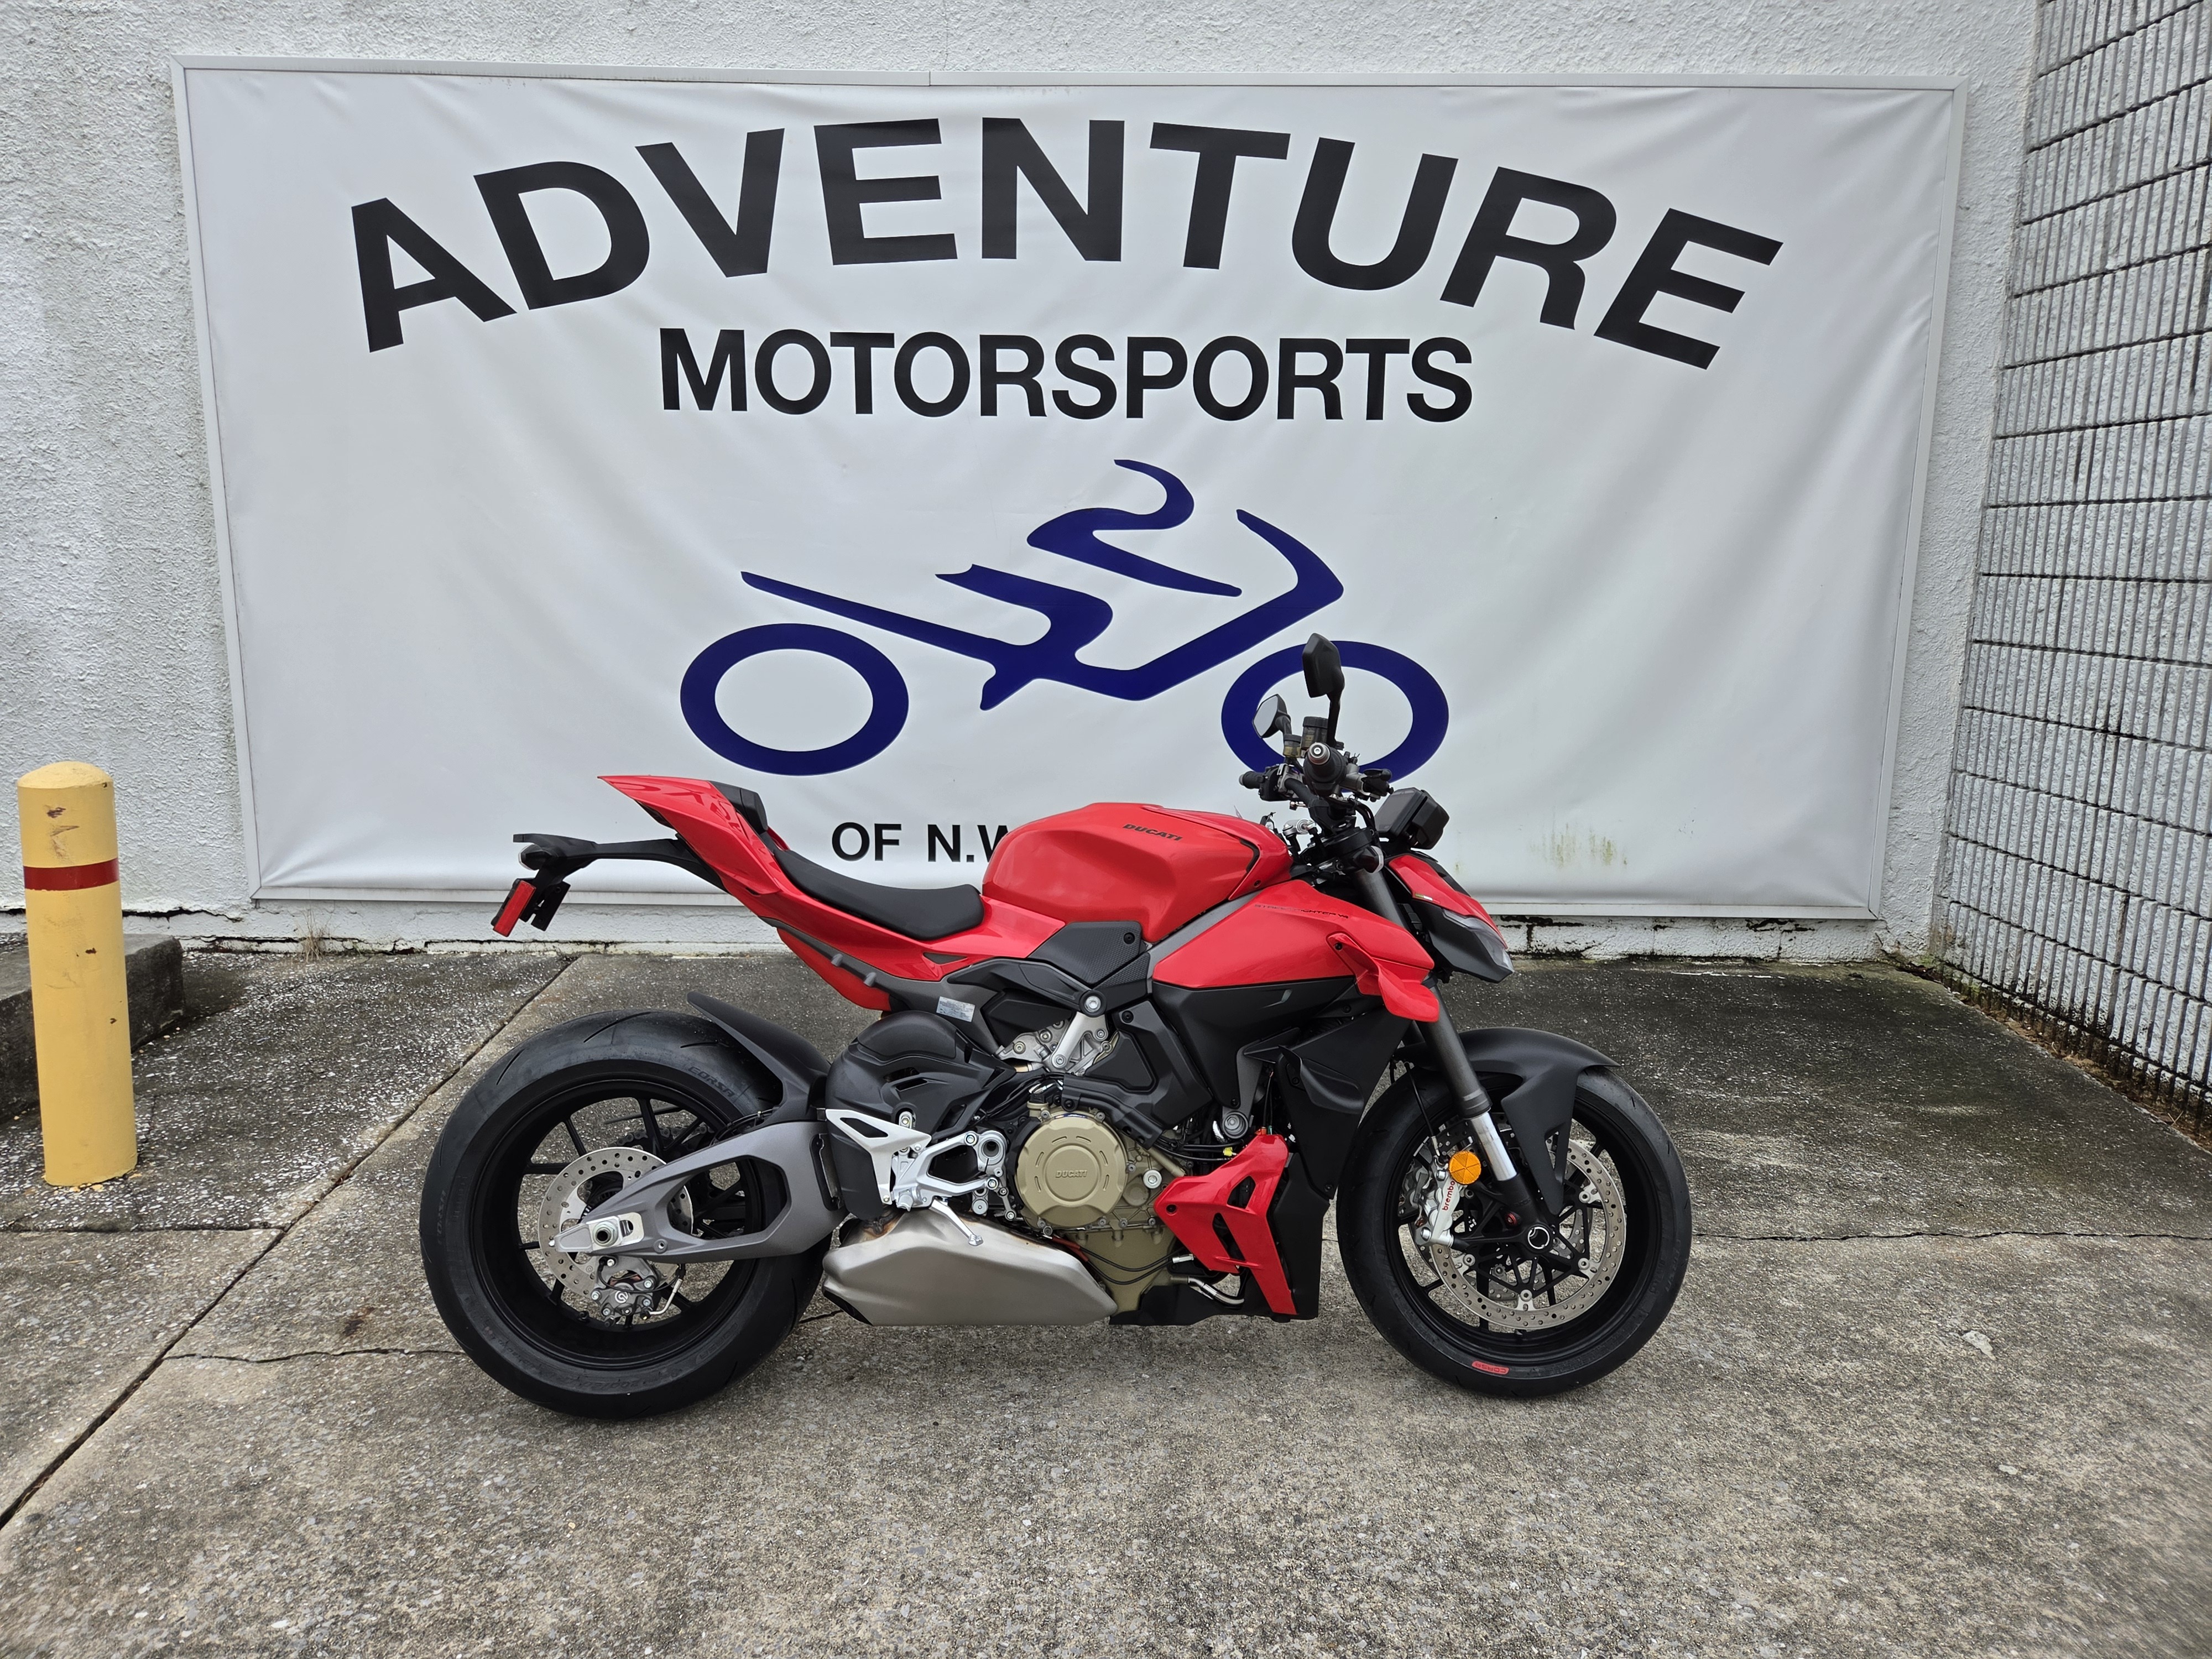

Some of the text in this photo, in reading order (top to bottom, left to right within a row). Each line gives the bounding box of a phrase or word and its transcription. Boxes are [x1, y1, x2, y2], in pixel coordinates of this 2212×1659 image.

[351, 117, 1784, 370] ADVENTURE
[660, 327, 1472, 422] MOTORSPORTS
[832, 822, 902, 862] OF
[1122, 823, 1183, 841] DUCATI
[688, 1066, 736, 1097] CORSA
[1055, 1168, 1088, 1178] DUCATI
[1442, 1180, 1455, 1211] brembo
[1474, 1361, 1506, 1374] CORSA
